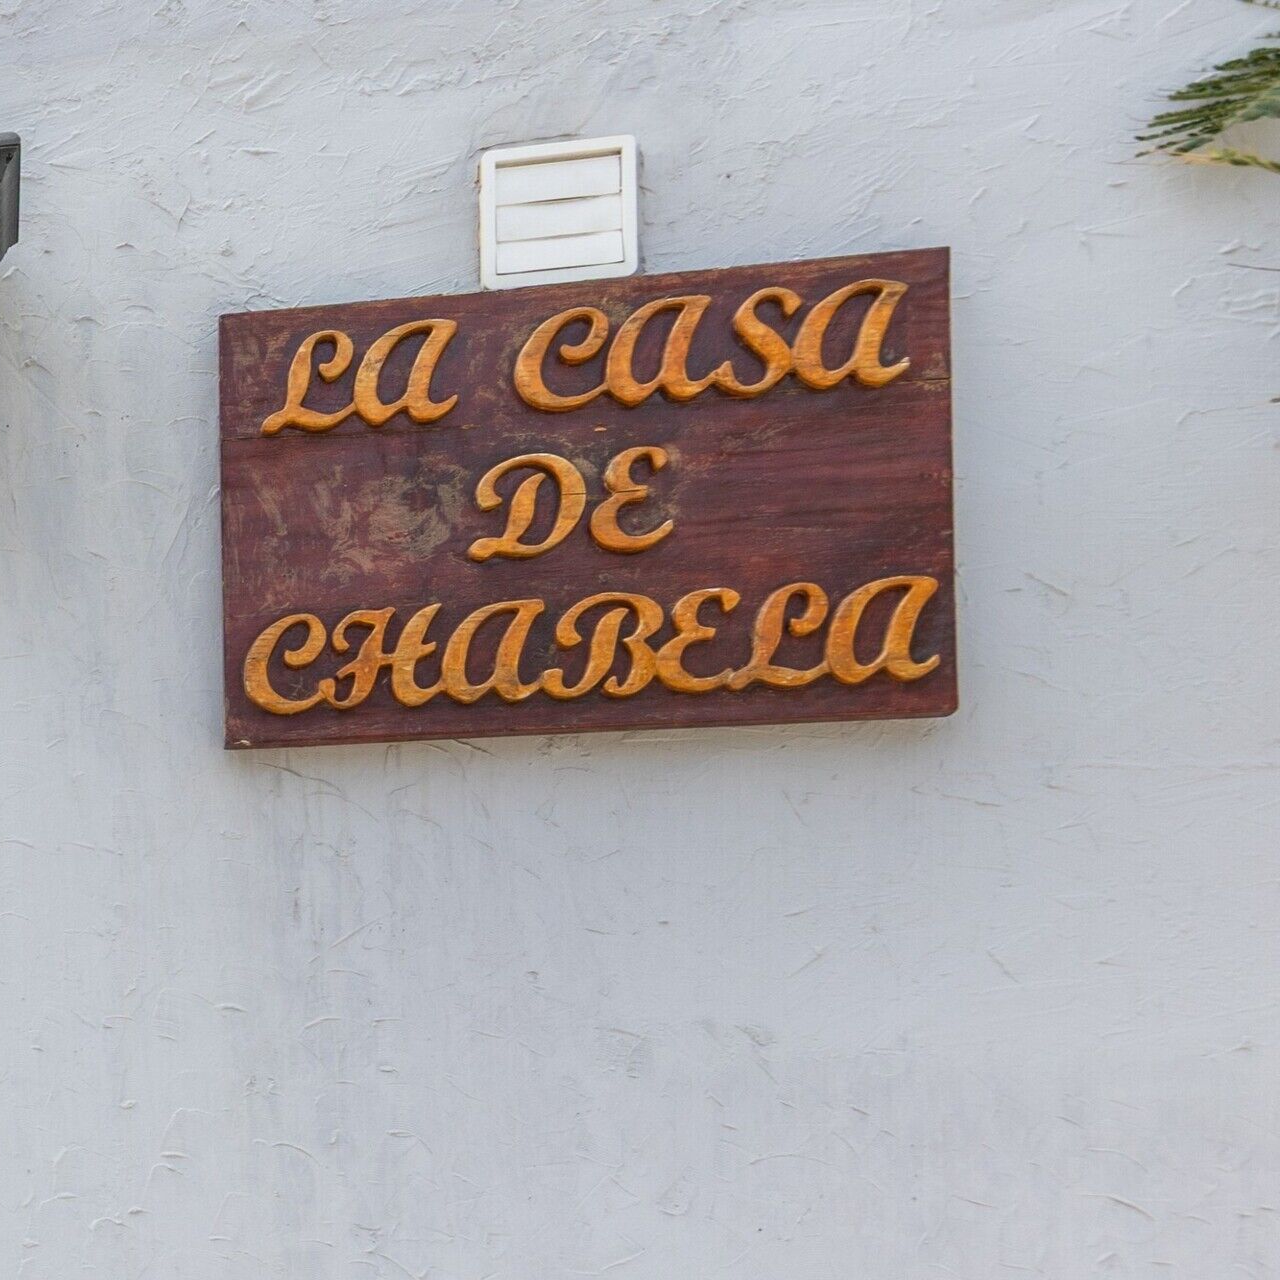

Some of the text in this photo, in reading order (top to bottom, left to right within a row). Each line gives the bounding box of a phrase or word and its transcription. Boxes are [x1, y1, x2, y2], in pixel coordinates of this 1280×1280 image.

[261, 277, 911, 435] LA CASA
[467, 445, 674, 562] DE
[243, 574, 940, 715] CHABELA
